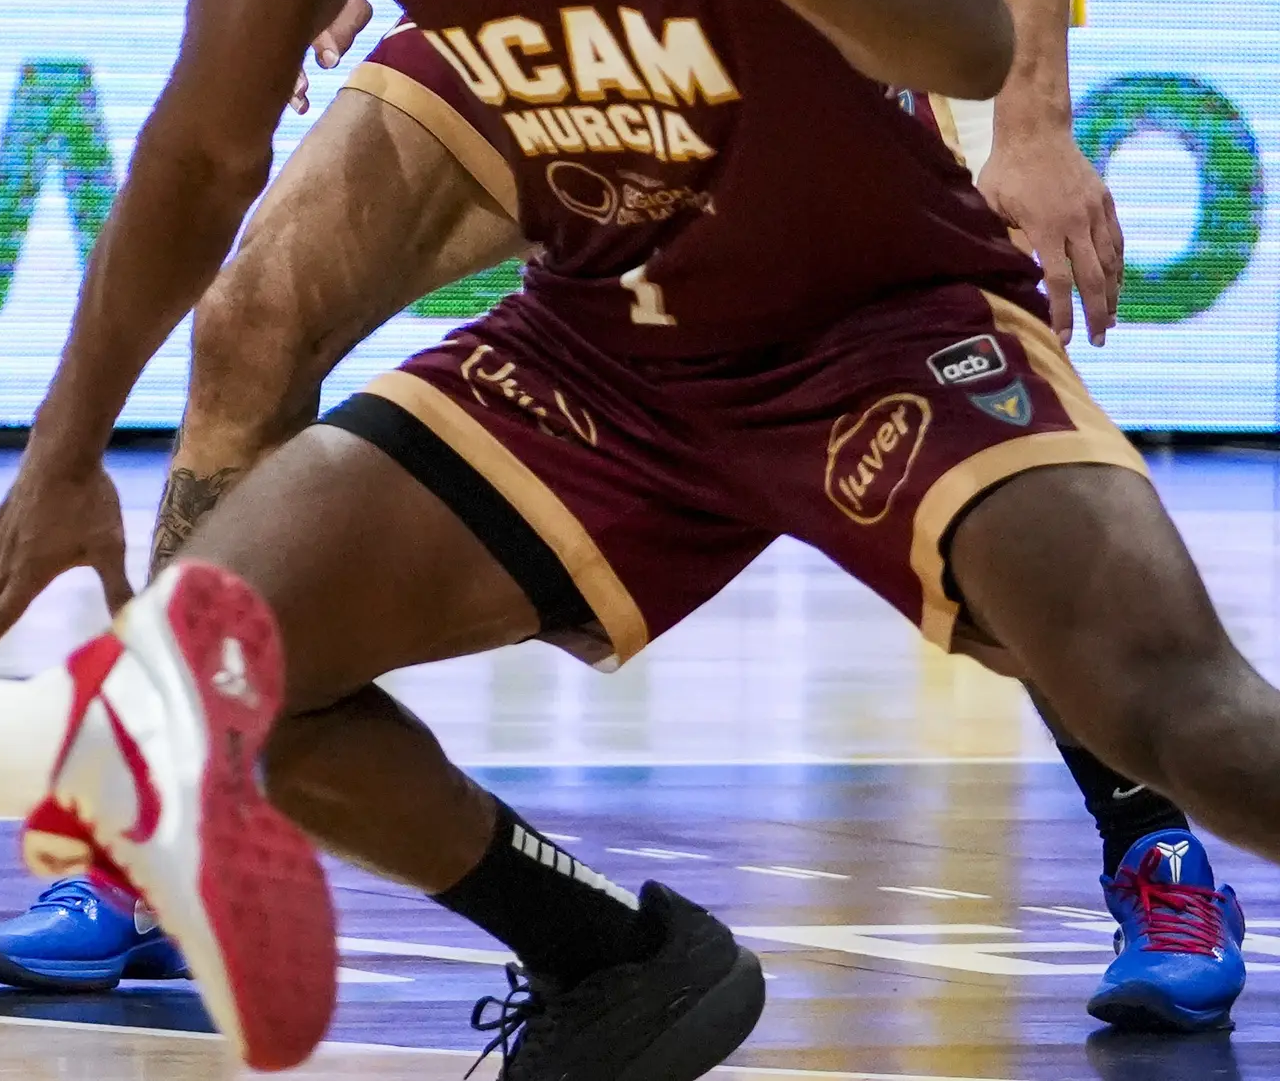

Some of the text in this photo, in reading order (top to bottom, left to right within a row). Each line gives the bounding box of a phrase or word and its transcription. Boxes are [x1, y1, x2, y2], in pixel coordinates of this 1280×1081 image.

[424, 6, 741, 106] UCAM
[503, 102, 719, 162] MURCIA
[942, 354, 990, 380] acb
